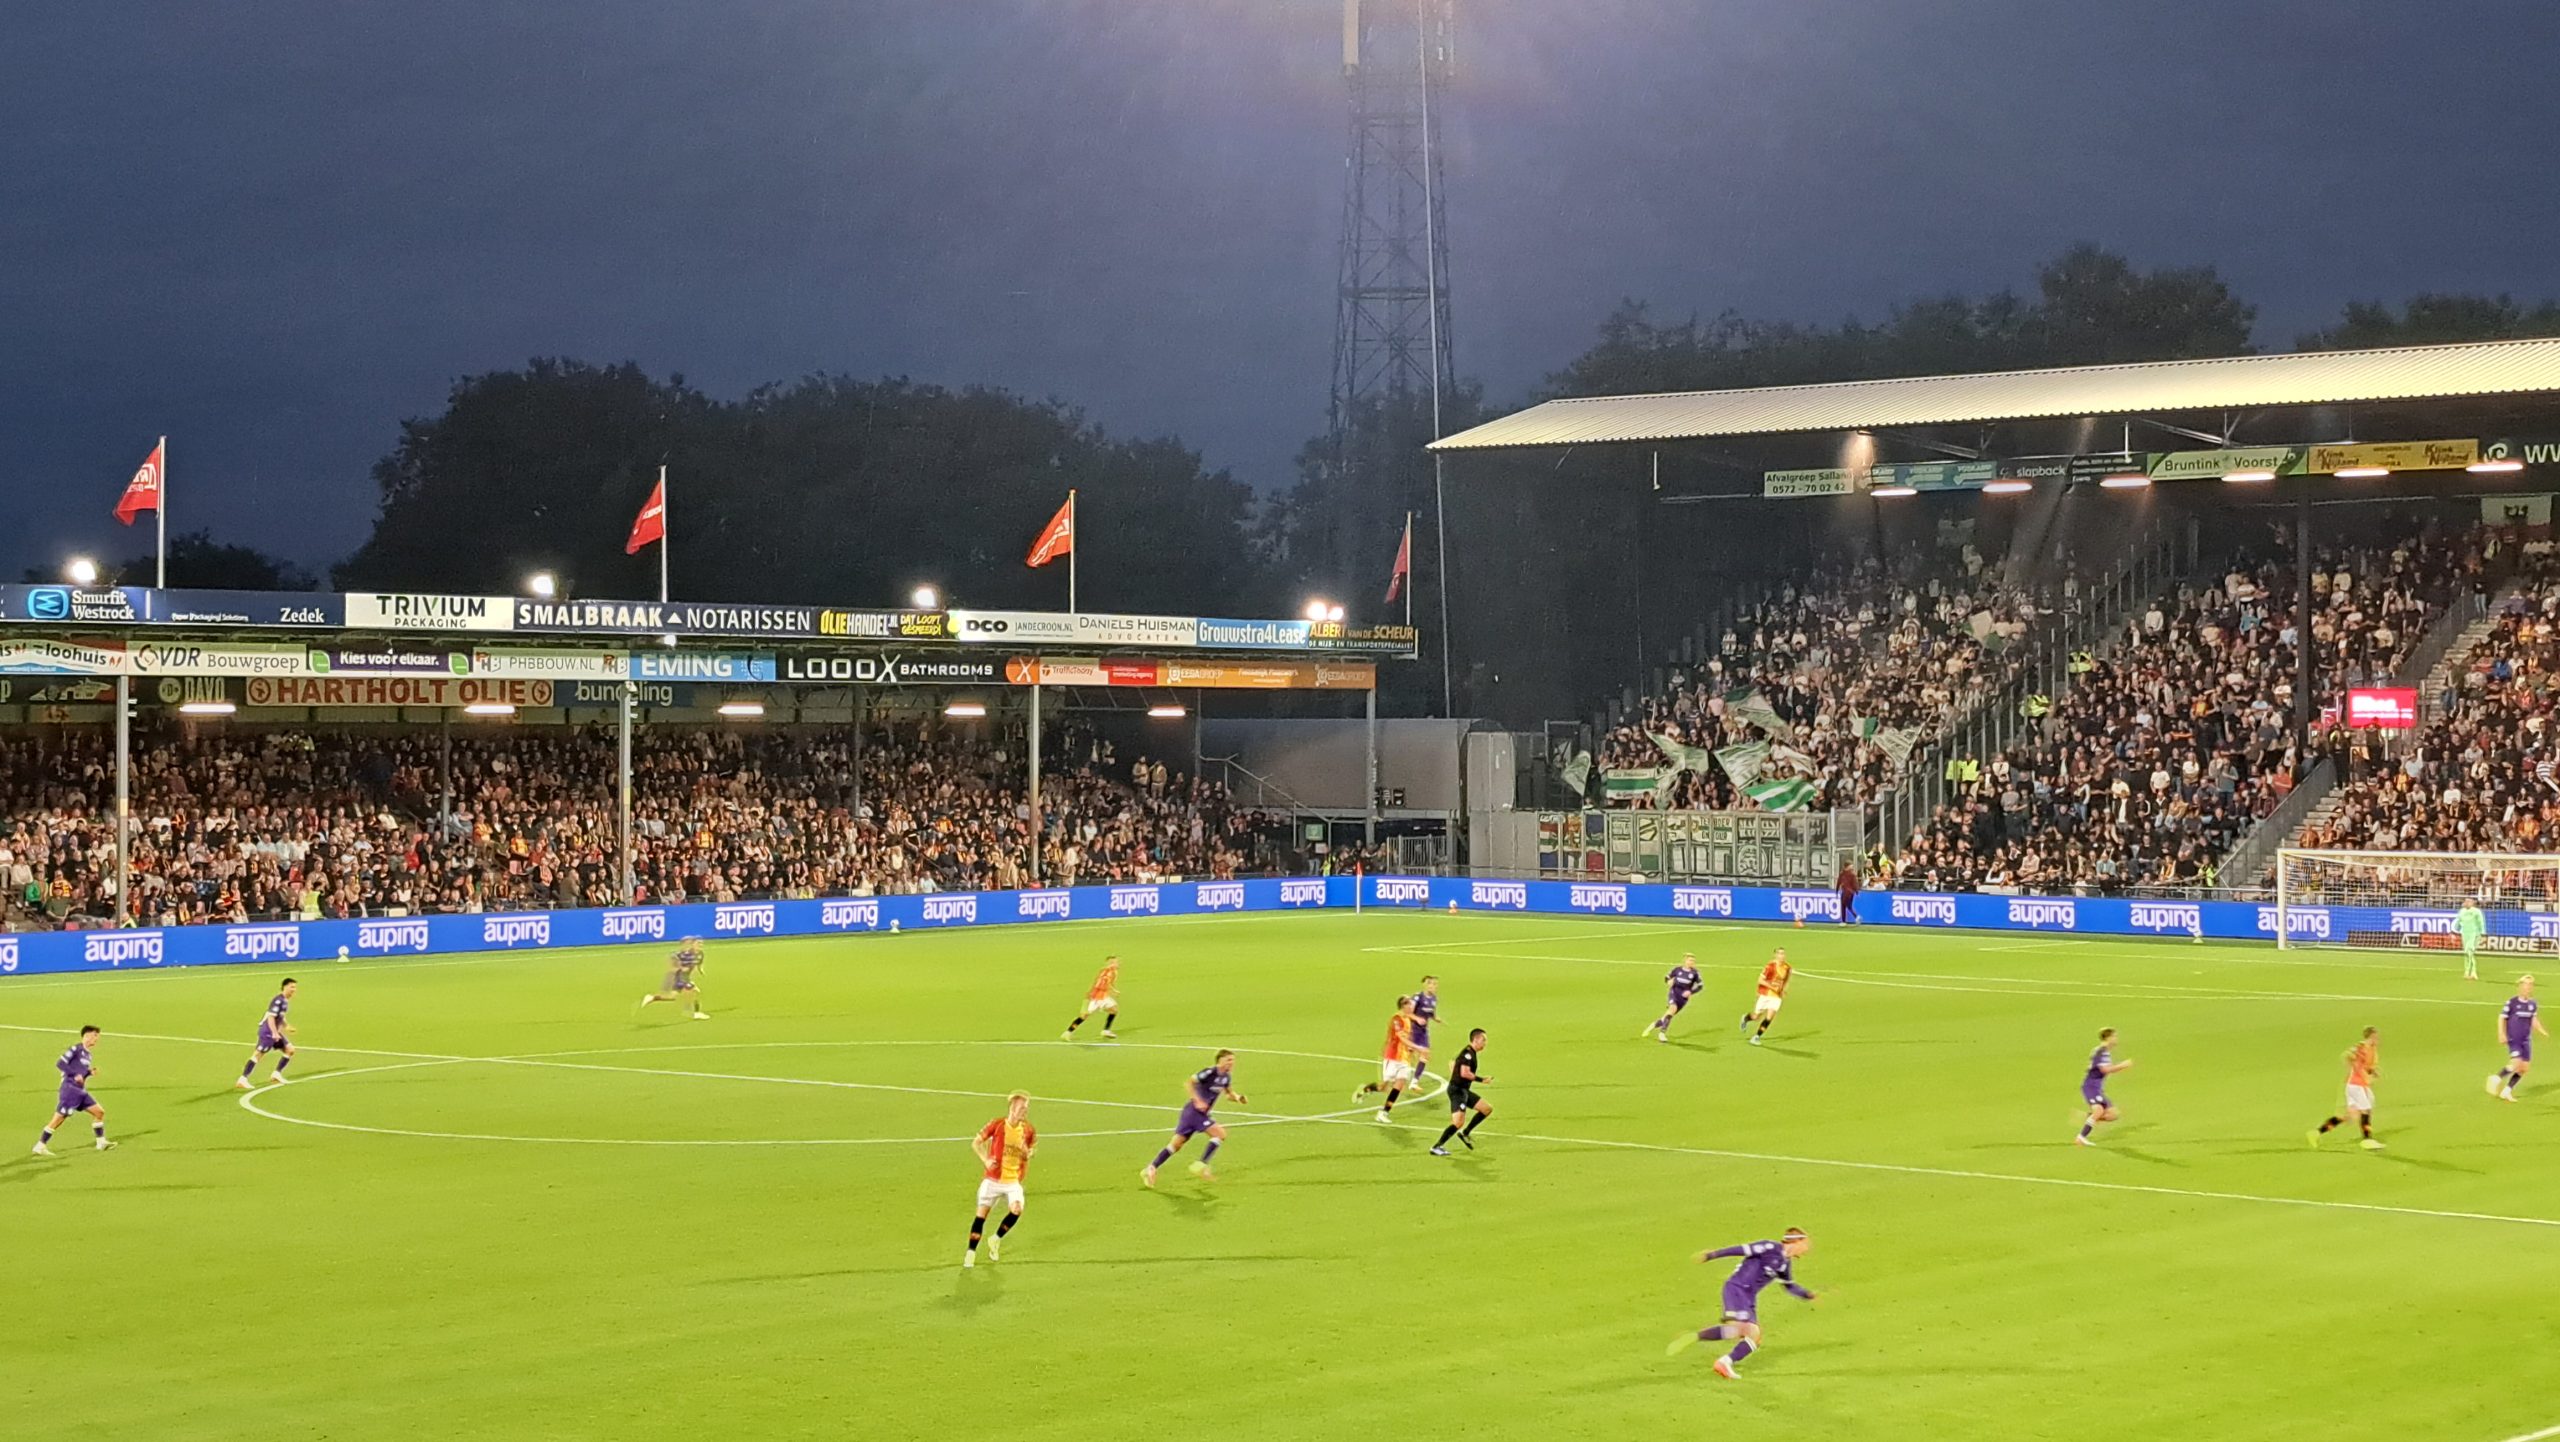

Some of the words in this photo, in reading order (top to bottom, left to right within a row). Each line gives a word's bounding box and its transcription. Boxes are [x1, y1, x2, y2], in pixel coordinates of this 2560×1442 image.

[2016, 465, 2066, 478] slapback
[2165, 460, 2220, 471] Bruntink
[2234, 456, 2277, 468] Voorst
[1766, 473, 1816, 484] Afvalgroep
[1805, 484, 1817, 492] 70
[72, 590, 126, 605] Smurfit
[376, 595, 486, 617] TRIVIUM
[72, 605, 134, 620] Westrock
[280, 607, 325, 623] Zedek
[394, 617, 467, 629] PACKAGING
[519, 604, 663, 628] SMALBRAAK
[687, 608, 810, 631] NOTARISSEN
[1079, 616, 1134, 630] DANIELS
[1137, 618, 1196, 632] HUISMAN
[966, 619, 1008, 633] DCO
[1098, 633, 1178, 642] ADVOCATEN
[1200, 622, 1306, 645] Grouwstra4Lease
[1309, 623, 1345, 638] ALBERT
[1373, 625, 1413, 640] SCHEUR
[45, 643, 107, 665] loohuis
[160, 646, 201, 668] VDR
[207, 653, 300, 673] Bouwgroep
[340, 651, 366, 666] Kies
[367, 654, 398, 666] voor
[399, 652, 440, 667] elkaar.
[641, 654, 733, 678] EMING
[900, 663, 993, 676] BATHROOMS
[277, 679, 446, 704] HARTHOLT
[458, 680, 526, 704] OLIE
[577, 681, 672, 706] bunling
[1110, 889, 1159, 913] auping
[1197, 885, 1244, 908] auping
[1280, 882, 1326, 907] auping
[1376, 881, 1429, 902] auping
[1472, 884, 1526, 909] auping
[1570, 887, 1626, 912] auping
[1673, 890, 1731, 916] auping
[822, 902, 878, 929] auping
[923, 897, 976, 923] auping
[1019, 893, 1070, 918] auping
[1780, 893, 1840, 919] auping
[1892, 897, 1956, 924] auping
[2008, 902, 2075, 929] auping
[484, 917, 550, 946] auping
[602, 911, 665, 939] auping
[715, 906, 774, 934] auping
[2130, 905, 2200, 934] auping
[225, 929, 299, 959] auping
[358, 922, 428, 952] auping
[85, 934, 163, 966] auping
